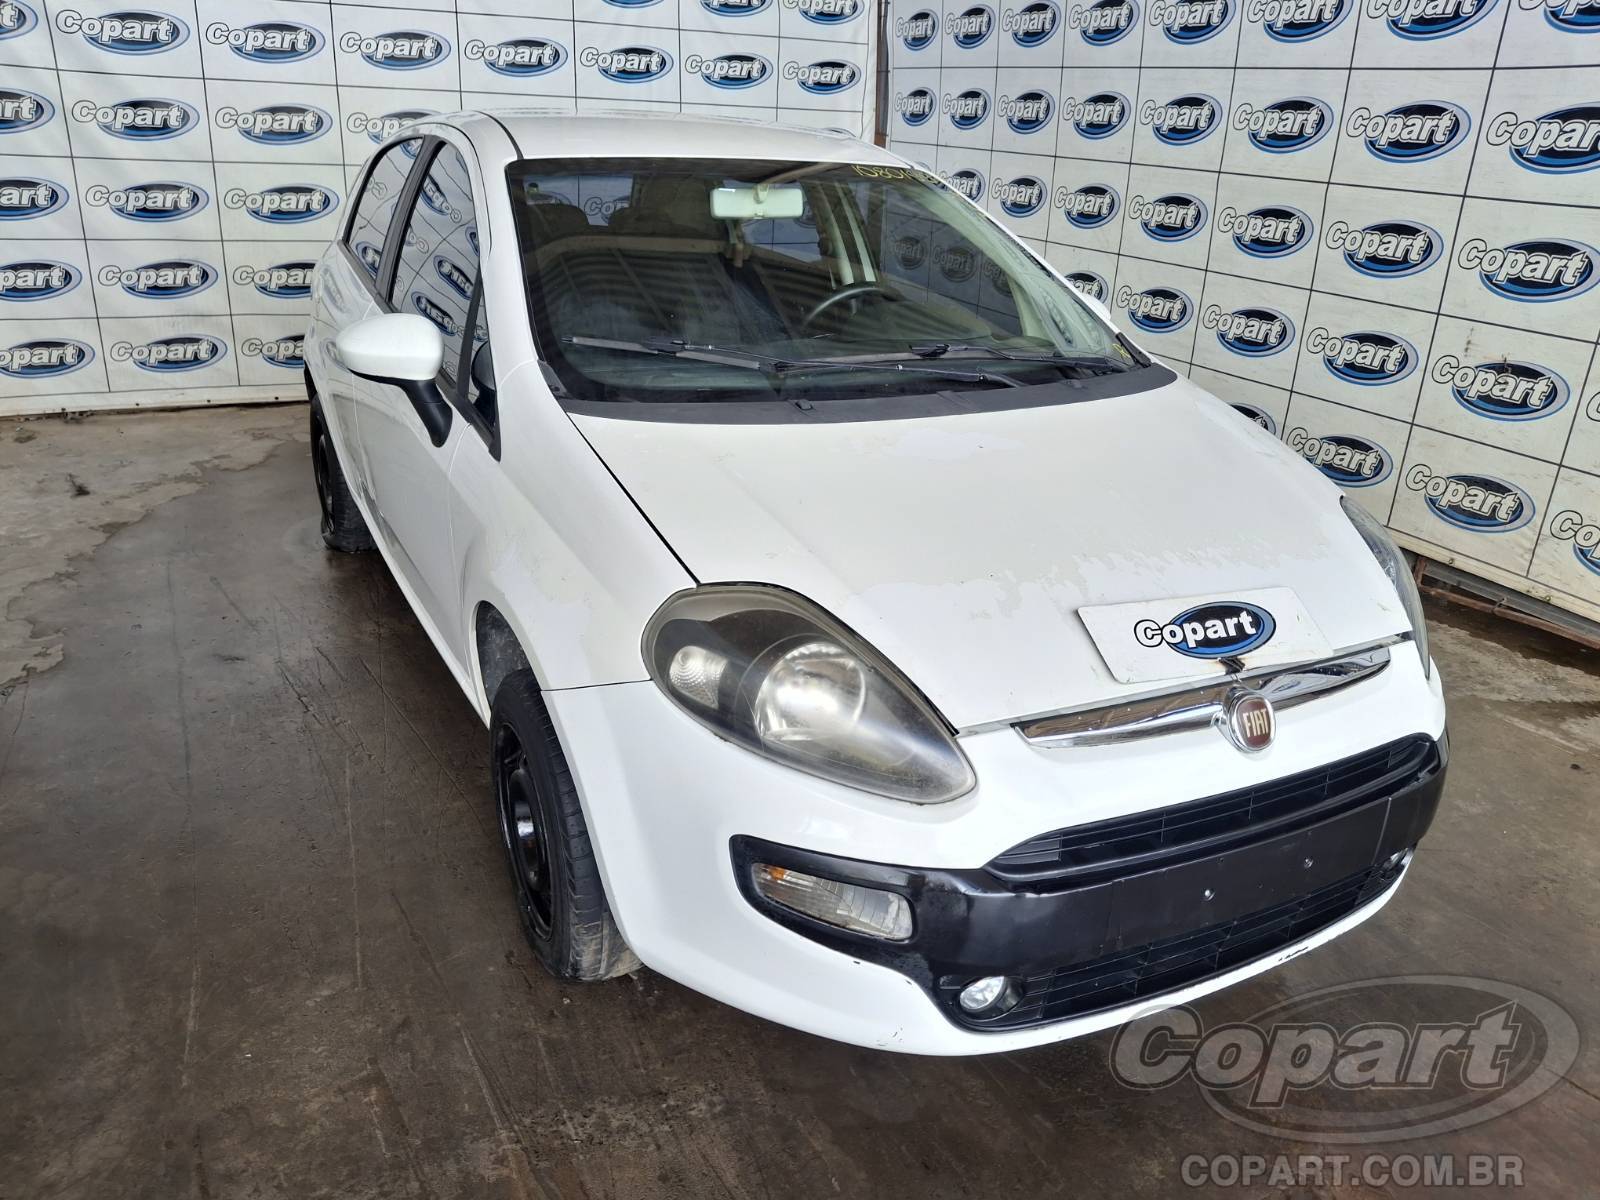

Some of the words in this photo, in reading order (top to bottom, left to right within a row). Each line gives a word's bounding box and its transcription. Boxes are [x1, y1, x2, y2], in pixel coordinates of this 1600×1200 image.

[56, 10, 174, 42] Copart
[896, 11, 936, 43] Copart
[945, 9, 990, 41] Copart
[1000, 7, 1057, 38] Copart
[1068, 3, 1131, 36] Copart
[1149, 0, 1230, 34] Copart
[1247, 0, 1338, 30] Copart
[206, 22, 312, 54] Copart
[340, 32, 436, 60] Copart
[465, 39, 556, 68] Copart
[581, 47, 665, 74] Copart
[685, 55, 764, 80] Copart
[783, 62, 854, 88] Copart
[71, 100, 184, 130] Copart
[215, 106, 318, 135] Copart
[895, 91, 931, 118] Copart
[942, 93, 986, 122] Copart
[998, 95, 1050, 126] Copart
[1063, 97, 1123, 127] Copart
[1140, 100, 1213, 129] Copart
[1233, 103, 1323, 140] Copart
[1346, 107, 1456, 147] Copart
[1486, 112, 1600, 157] Copar
[85, 184, 192, 214] Copart
[224, 187, 324, 214] Copart
[991, 178, 1043, 208] Copart
[1055, 186, 1111, 216] Copart
[1128, 196, 1201, 229] Copart
[1217, 207, 1302, 244] Copart
[1326, 221, 1429, 262] Copart
[1458, 239, 1588, 285] Copart
[98, 264, 203, 293] Copart
[1116, 285, 1186, 323] Copart
[1202, 304, 1285, 346] Copart
[110, 339, 213, 367] Copart
[1306, 327, 1405, 373] Copart
[1432, 355, 1552, 408] Copart
[1286, 427, 1383, 477] Copart
[1405, 464, 1520, 521] Copart
[1134, 610, 1257, 649] Copart
[1242, 706, 1269, 739] FIAT
